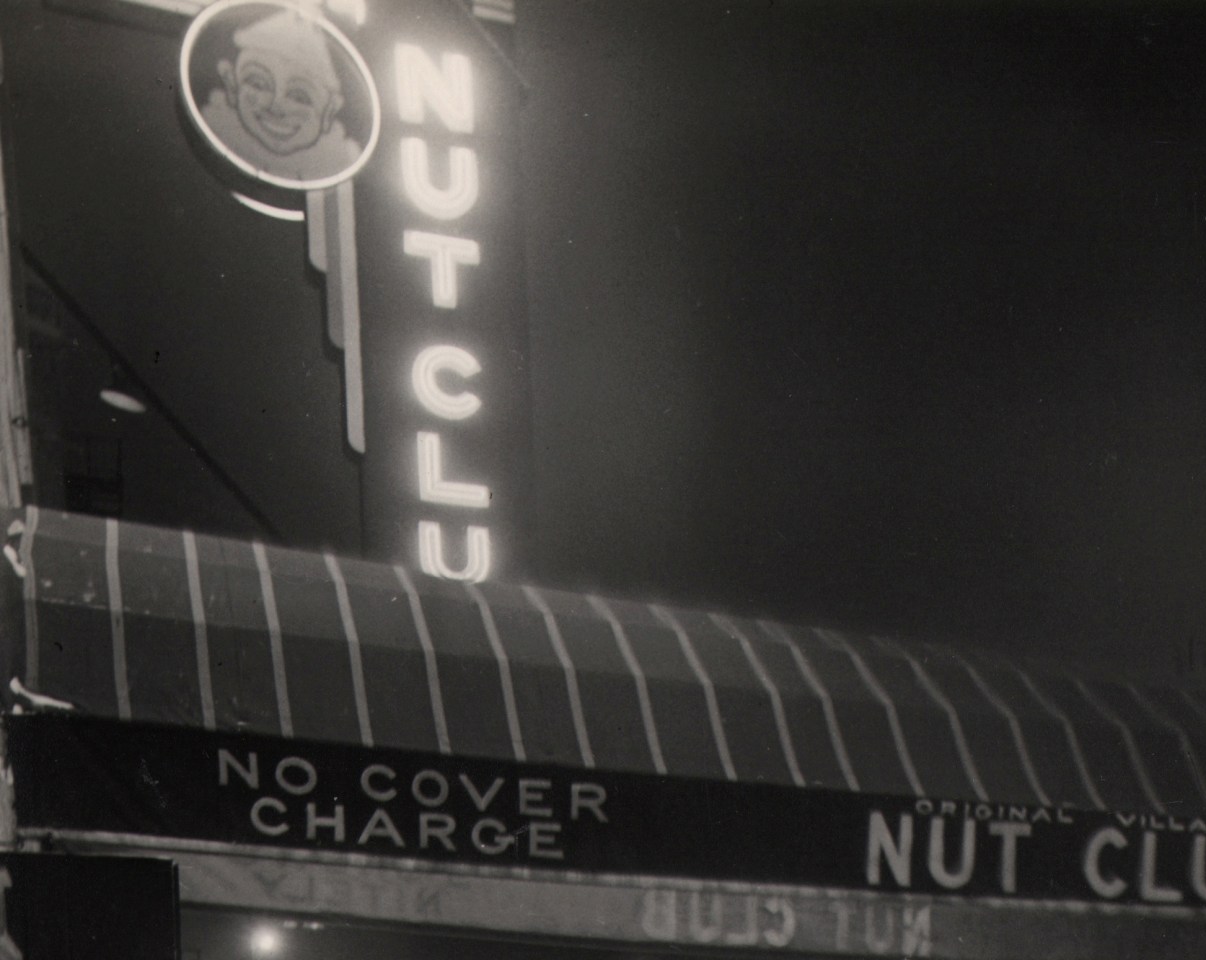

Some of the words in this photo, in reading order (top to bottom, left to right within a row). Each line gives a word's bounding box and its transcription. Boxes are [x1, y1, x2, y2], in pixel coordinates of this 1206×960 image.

[394, 42, 482, 310] NUT
[216, 747, 318, 796] NO
[358, 762, 610, 824] COVER
[914, 800, 1074, 824] ORIGINAL
[248, 795, 566, 860] CHARGE
[866, 810, 1032, 894] NUT
